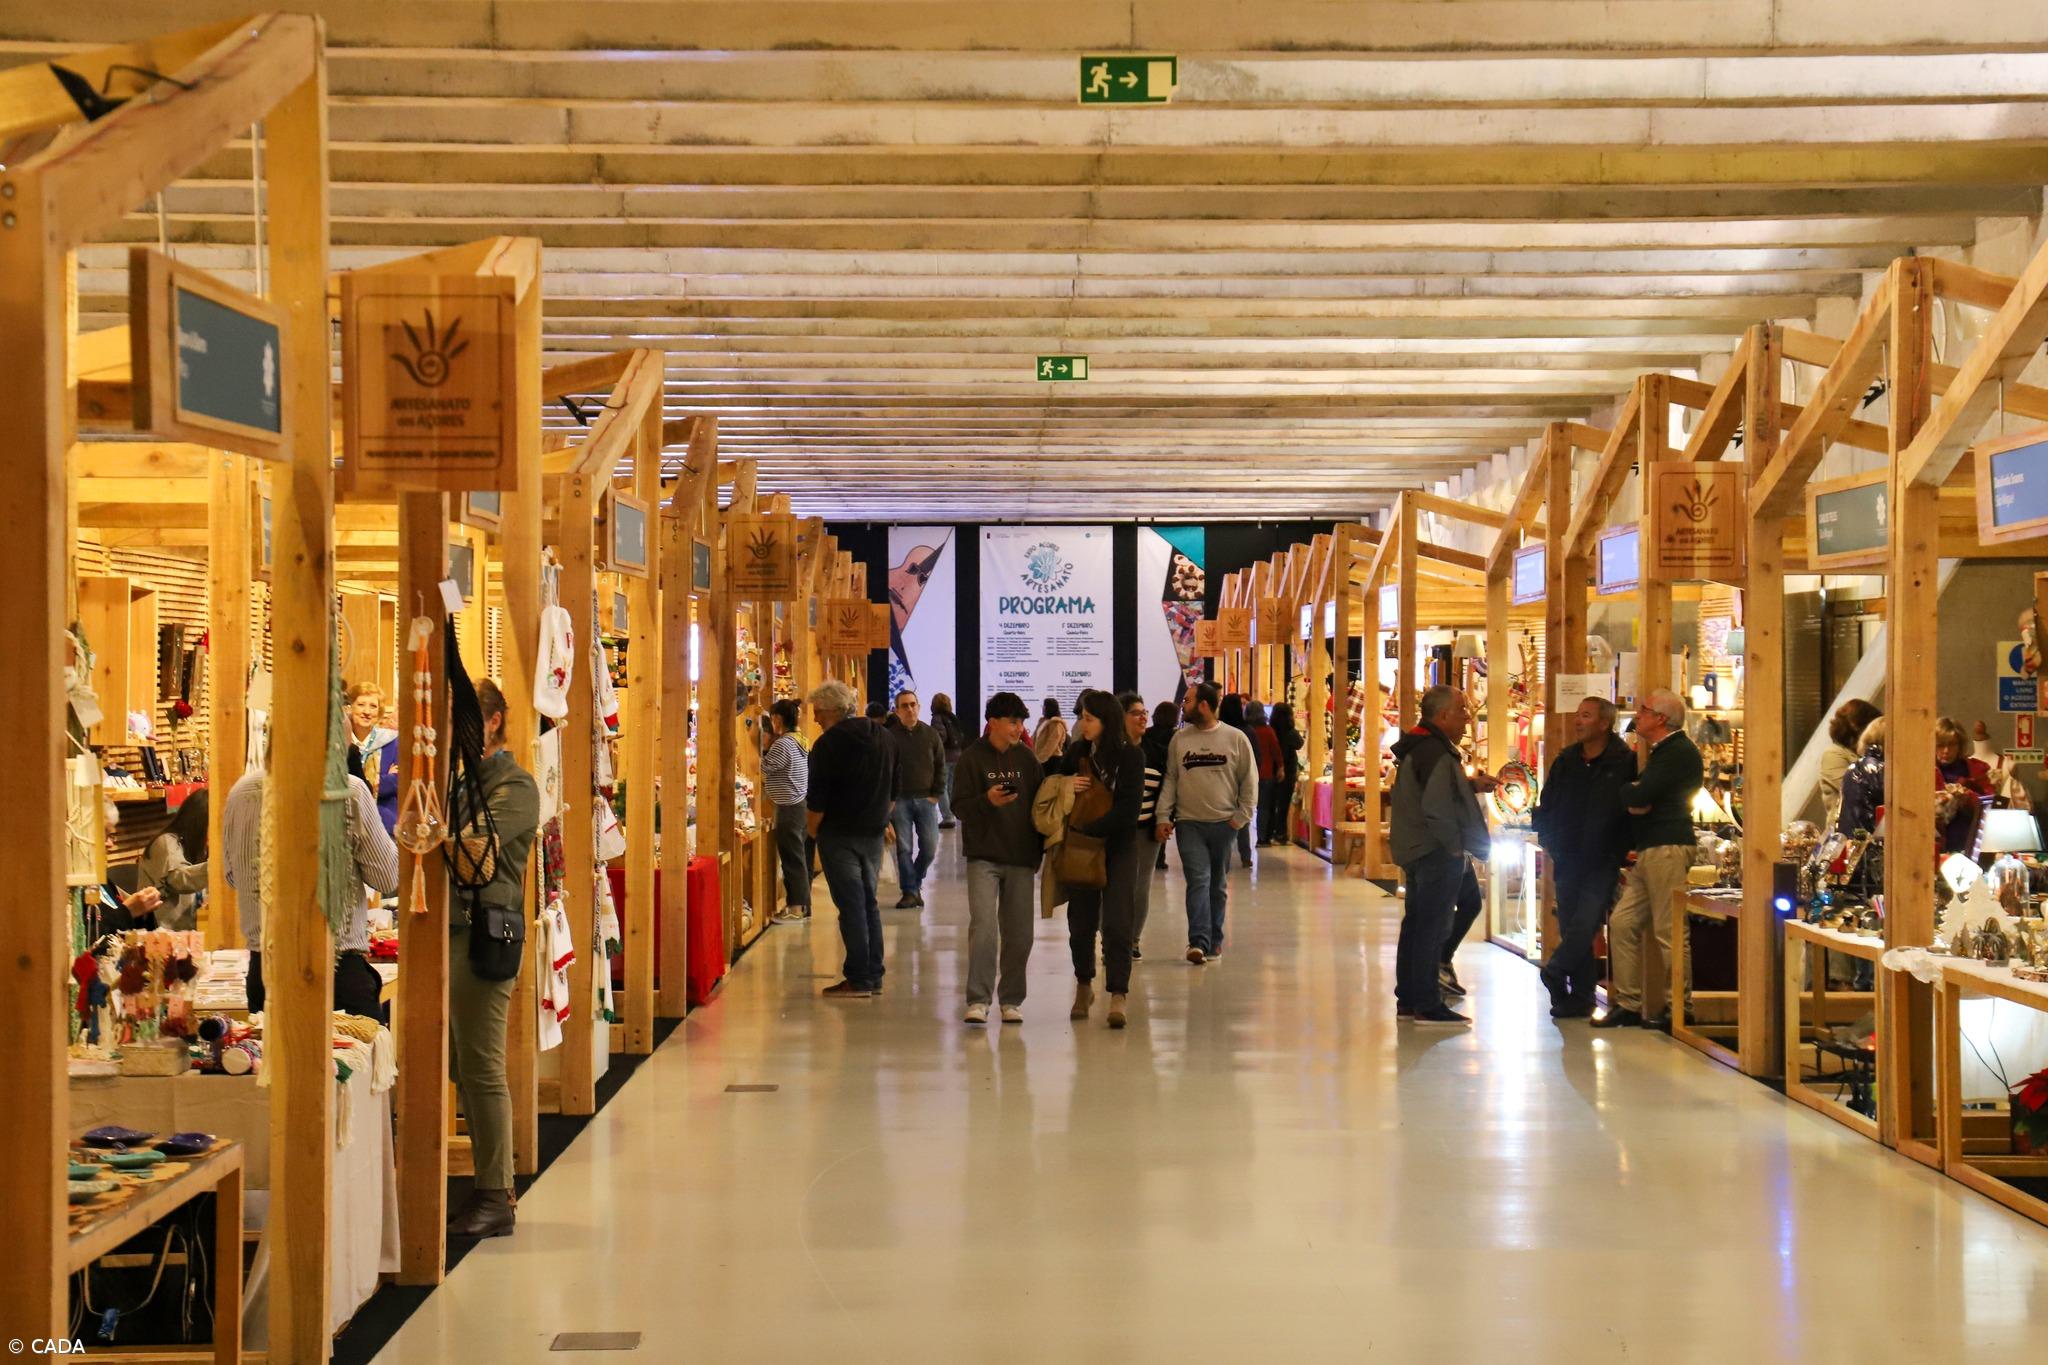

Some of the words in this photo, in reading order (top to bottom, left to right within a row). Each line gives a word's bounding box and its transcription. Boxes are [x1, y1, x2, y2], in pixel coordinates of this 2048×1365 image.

[390, 398, 471, 411] ARTESANATO
[1020, 562, 1073, 593] ARTESANATO
[999, 596, 1096, 614] PROGRAMA
[986, 771, 1021, 779] GANT
